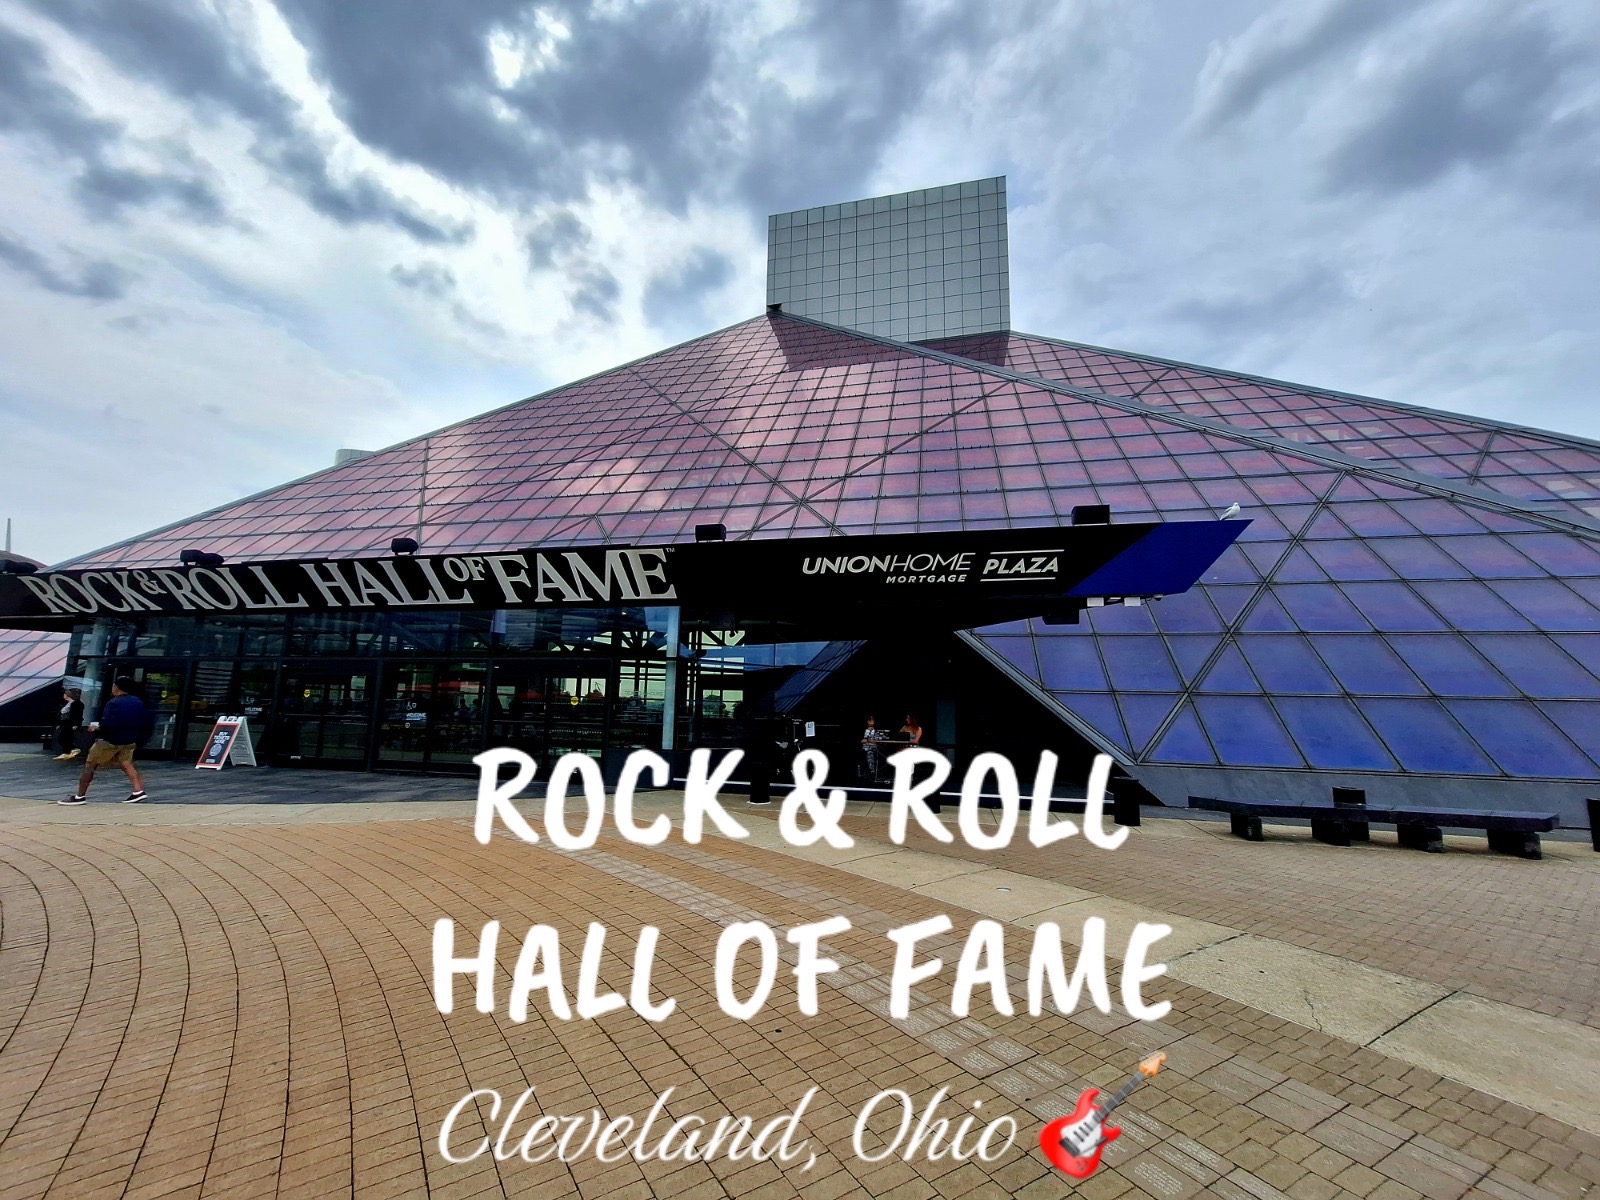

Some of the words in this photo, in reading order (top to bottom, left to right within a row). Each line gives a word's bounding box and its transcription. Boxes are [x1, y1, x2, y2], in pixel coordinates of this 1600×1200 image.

[982, 556, 1059, 575] PLAZA
[299, 558, 474, 607] HALL
[444, 556, 486, 582] OF
[483, 549, 677, 603] FAME
[885, 574, 967, 584] MORTGAGE
